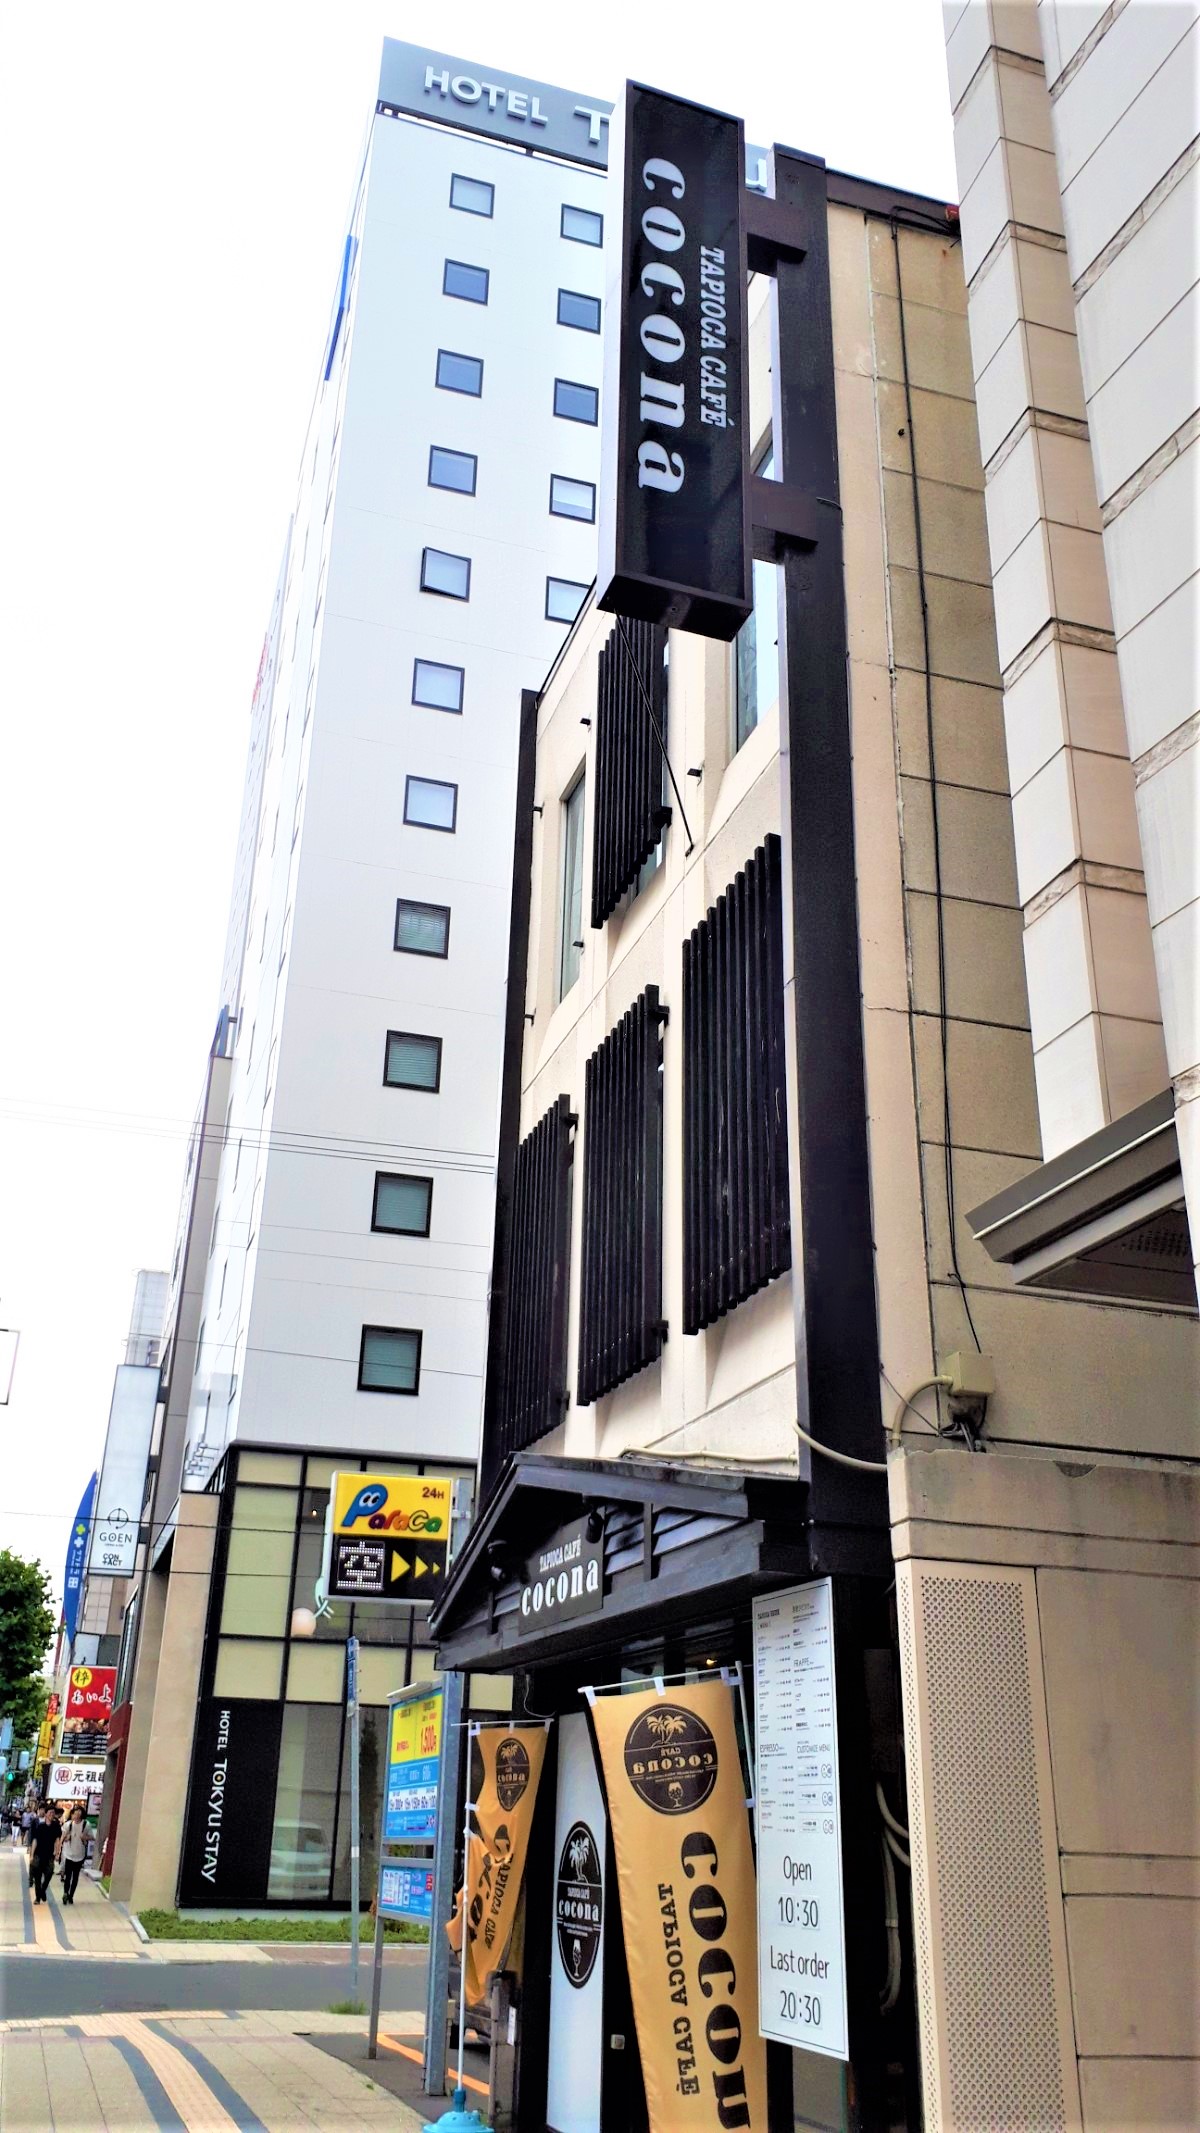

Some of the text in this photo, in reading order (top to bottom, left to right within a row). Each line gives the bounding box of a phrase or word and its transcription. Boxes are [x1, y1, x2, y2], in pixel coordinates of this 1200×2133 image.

[424, 65, 548, 126] HOTEL
[638, 157, 686, 493] cocona
[700, 246, 735, 428] TAPIOCA CAFÉ
[422, 1486, 445, 1499] 24H
[99, 1532, 133, 1543] GOEN
[338, 1541, 384, 1590] 空
[522, 1560, 599, 1616] cocona
[201, 1710, 231, 1883] HOTEL TOKYU STAY
[783, 1855, 812, 1886] Open
[558, 1900, 599, 1922] cocona
[778, 1896, 819, 1928] 10:30
[770, 1945, 830, 1979] Last order
[780, 1990, 821, 2026] 20:30
